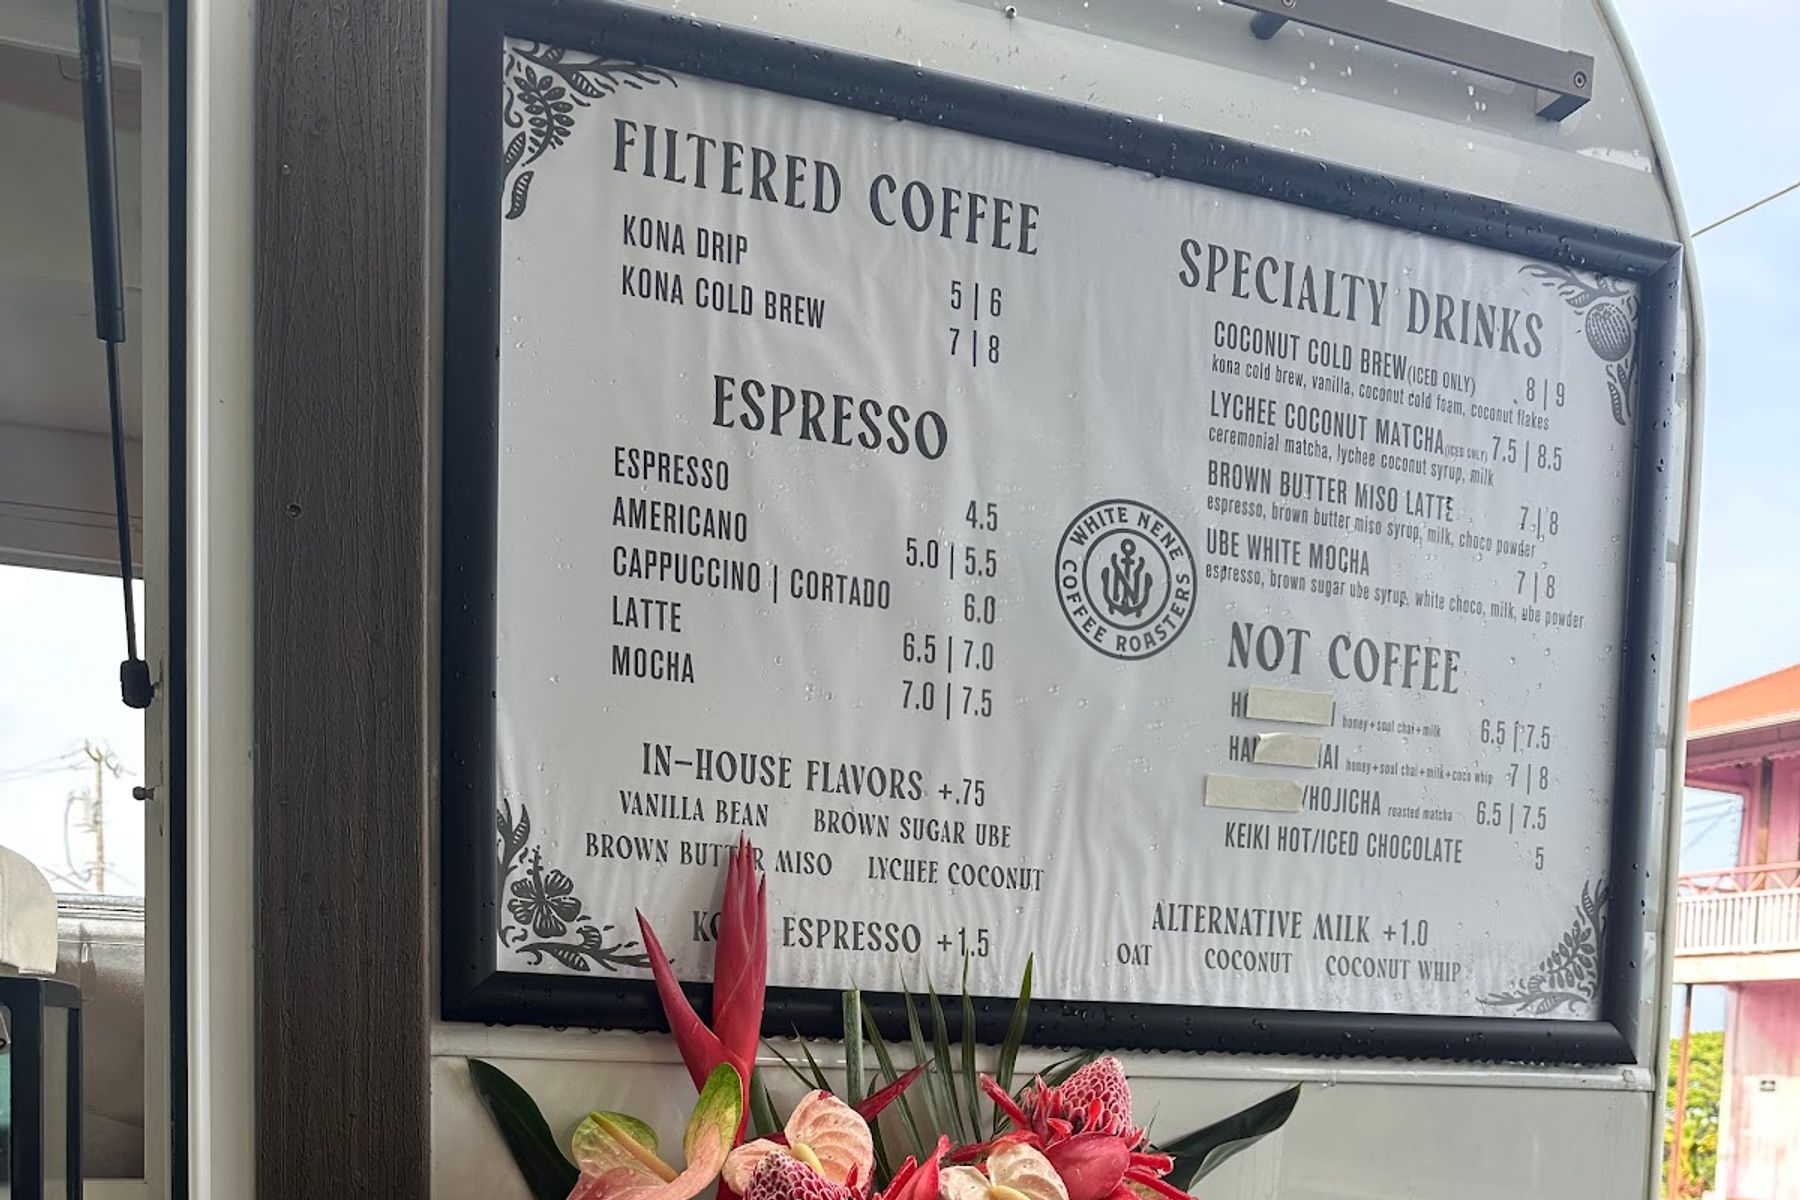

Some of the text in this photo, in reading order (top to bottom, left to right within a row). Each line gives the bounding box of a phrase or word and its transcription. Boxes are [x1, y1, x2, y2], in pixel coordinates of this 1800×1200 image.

[613, 118, 1040, 255] FILTERED COFFEE
[623, 214, 748, 265] KONA DRIP
[622, 265, 825, 329] KONA COLD BREW
[1179, 238, 1543, 358] SPECIALTY DRINKS
[1214, 320, 1300, 361] COCONUT
[1308, 338, 1352, 371] COLD
[1443, 372, 1475, 397] ONLY)
[712, 374, 948, 460] ESPRESSO
[1210, 390, 1276, 426] LYCHEE
[1285, 403, 1368, 441] COCONUT
[1212, 353, 1550, 431] kona cold brew, vanilla, coconut cold foam, coconut flakes
[614, 446, 729, 490] ESPRESSO
[1208, 426, 1494, 486] ceremonial matcha, lychee coconut syrup, milk
[966, 500, 998, 531] 4.5
[1208, 459, 1454, 522] BROWN BUTTER MISO LATTE
[613, 497, 747, 542] AMERICANO
[1070, 506, 1184, 561] WHITE NENE
[1207, 495, 1535, 558] espresso, brown butter miso syrup, milk, choco powder
[1207, 527, 1369, 576] UBE WHITE MOCHA
[613, 545, 890, 610] CAPPUCCINO CORTADO
[1206, 563, 1264, 588] espresso,
[1270, 569, 1305, 591] brown
[1311, 578, 1345, 597] sugar
[1350, 581, 1369, 599] ube
[1415, 590, 1445, 610] white
[1491, 601, 1517, 622] milk,
[1522, 606, 1540, 623] ube
[1545, 610, 1584, 629] powder
[613, 596, 681, 633] LATTE
[964, 593, 995, 624] 6.0
[1062, 559, 1191, 652] COFFEE ROASTERS
[612, 645, 694, 683] MOCHA
[1227, 620, 1460, 694] NOT COFFEE
[642, 742, 985, 807] IN-HOUSE FLAVORS +.75
[620, 790, 769, 827] VANILLA BEAN
[814, 809, 1011, 848] BROWN SUGAR UBE
[1387, 805, 1420, 819] roasted
[1422, 808, 1453, 822] matcha
[586, 832, 832, 876] BROWN BUTTR MISO
[1225, 822, 1463, 864] KEIKI HOT/ICED CHOCOLATE
[1535, 846, 1544, 871] 5
[868, 857, 1044, 892] LYCHEE COCONUT
[782, 916, 921, 954] ESPRESSO
[1152, 901, 1428, 946] ALTERNATIVE MILK +1.0
[1116, 943, 1462, 983] OAT COCONUT COCONUT WHIP
